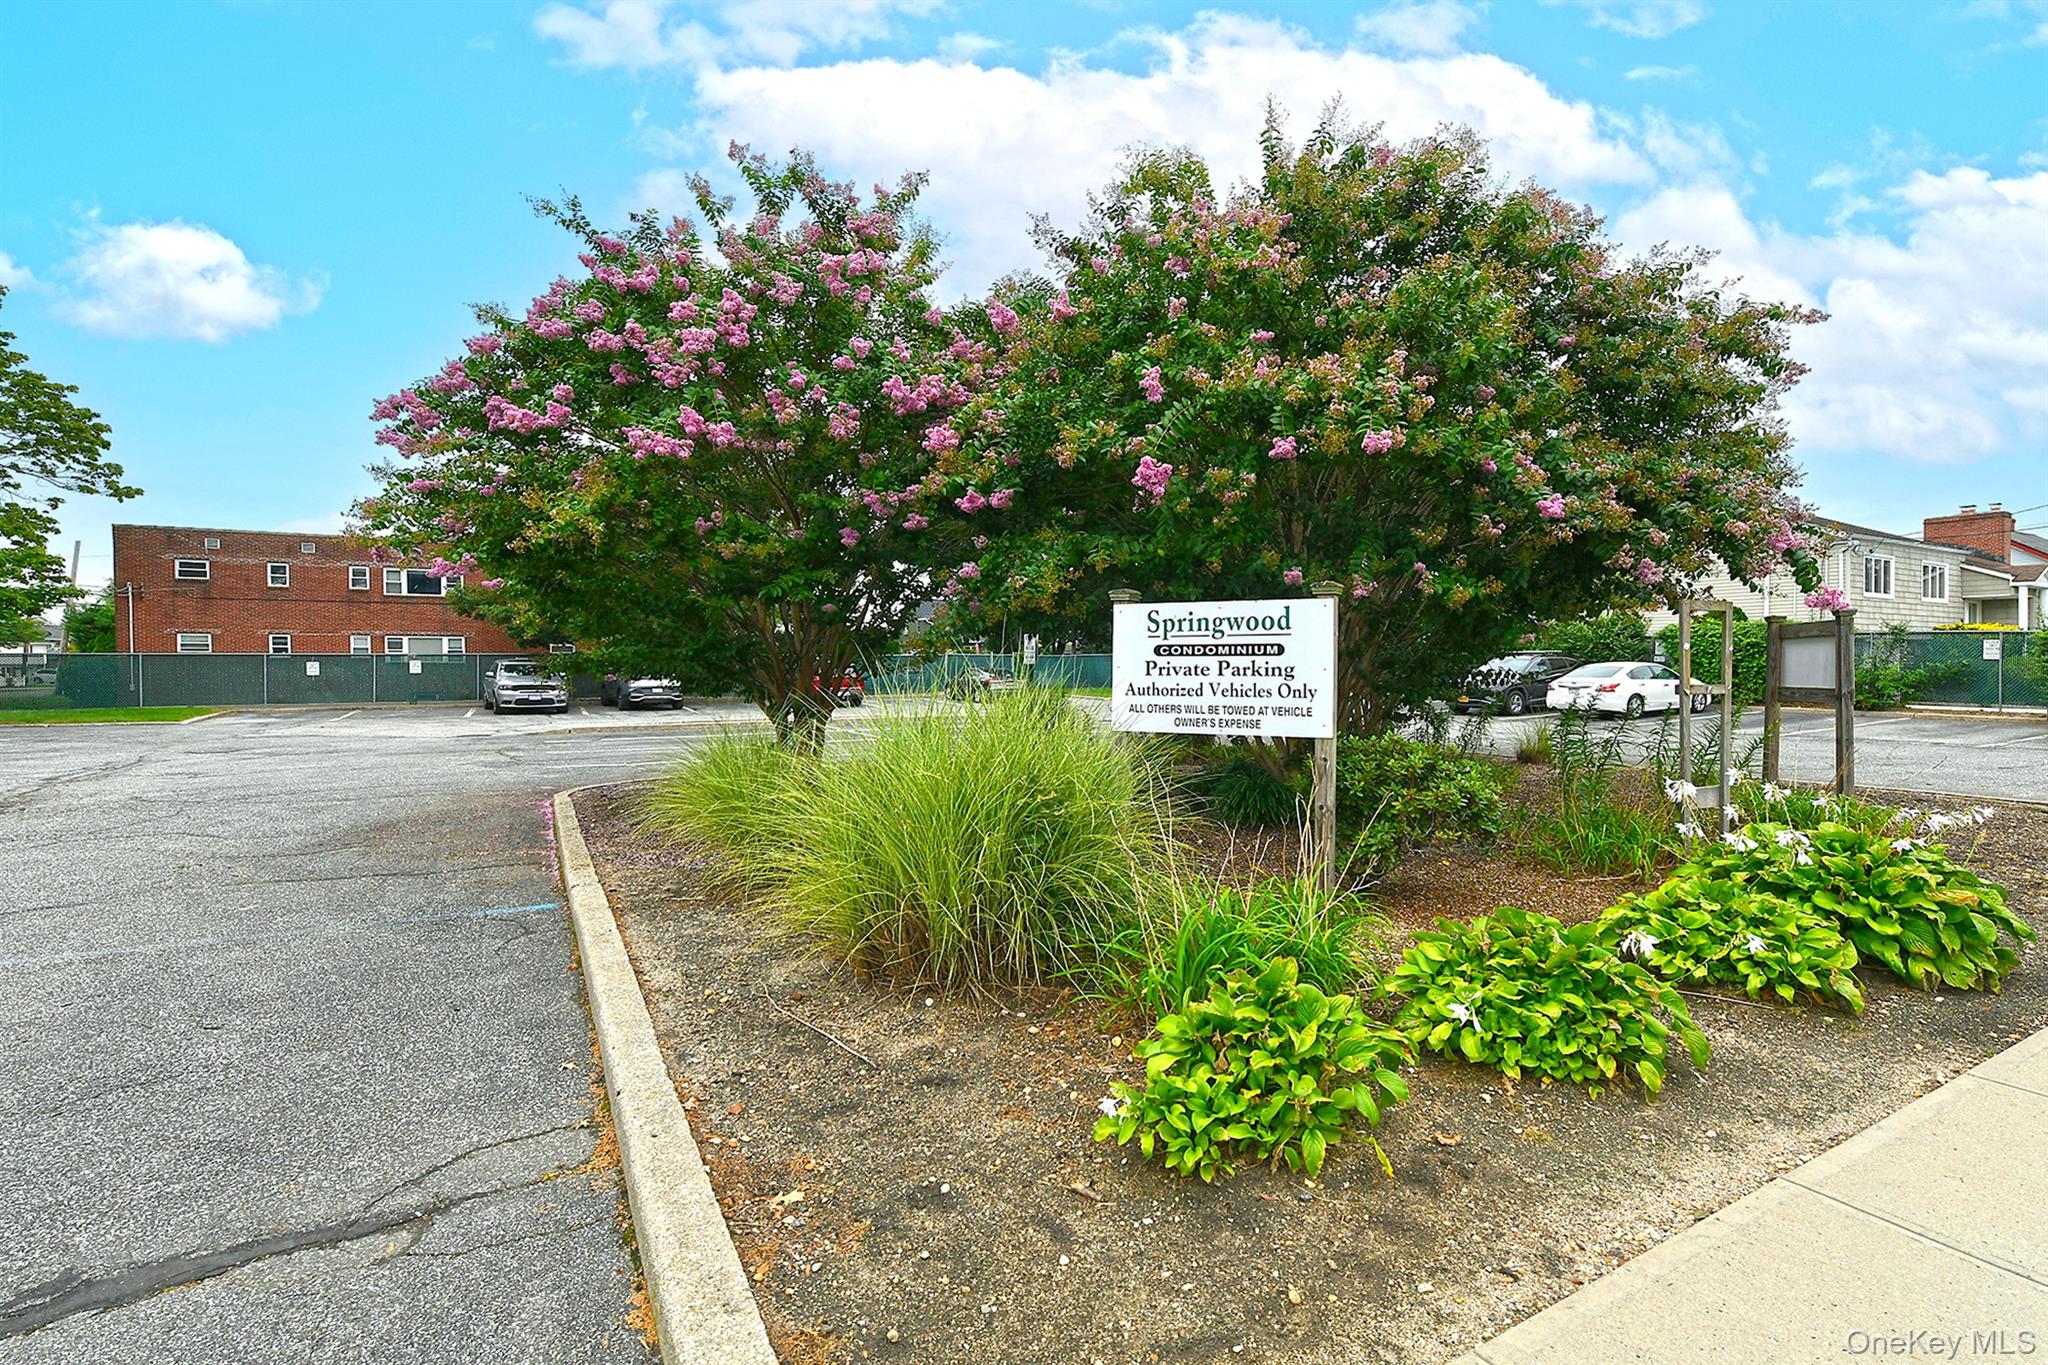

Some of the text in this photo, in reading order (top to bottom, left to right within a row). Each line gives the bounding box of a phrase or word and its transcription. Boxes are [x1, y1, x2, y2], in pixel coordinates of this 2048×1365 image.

[1147, 605, 1292, 641] Springwood
[1159, 645, 1279, 656] CONDOMINIUM
[1145, 659, 1295, 681] Private Parking
[1125, 682, 1318, 702] Authorized Vehicles Only
[1128, 704, 1313, 717] ALL OTHERS WILL BE TOWED AT VEHICLE
[1174, 717, 1261, 729] OWNER'S EXPENSE
